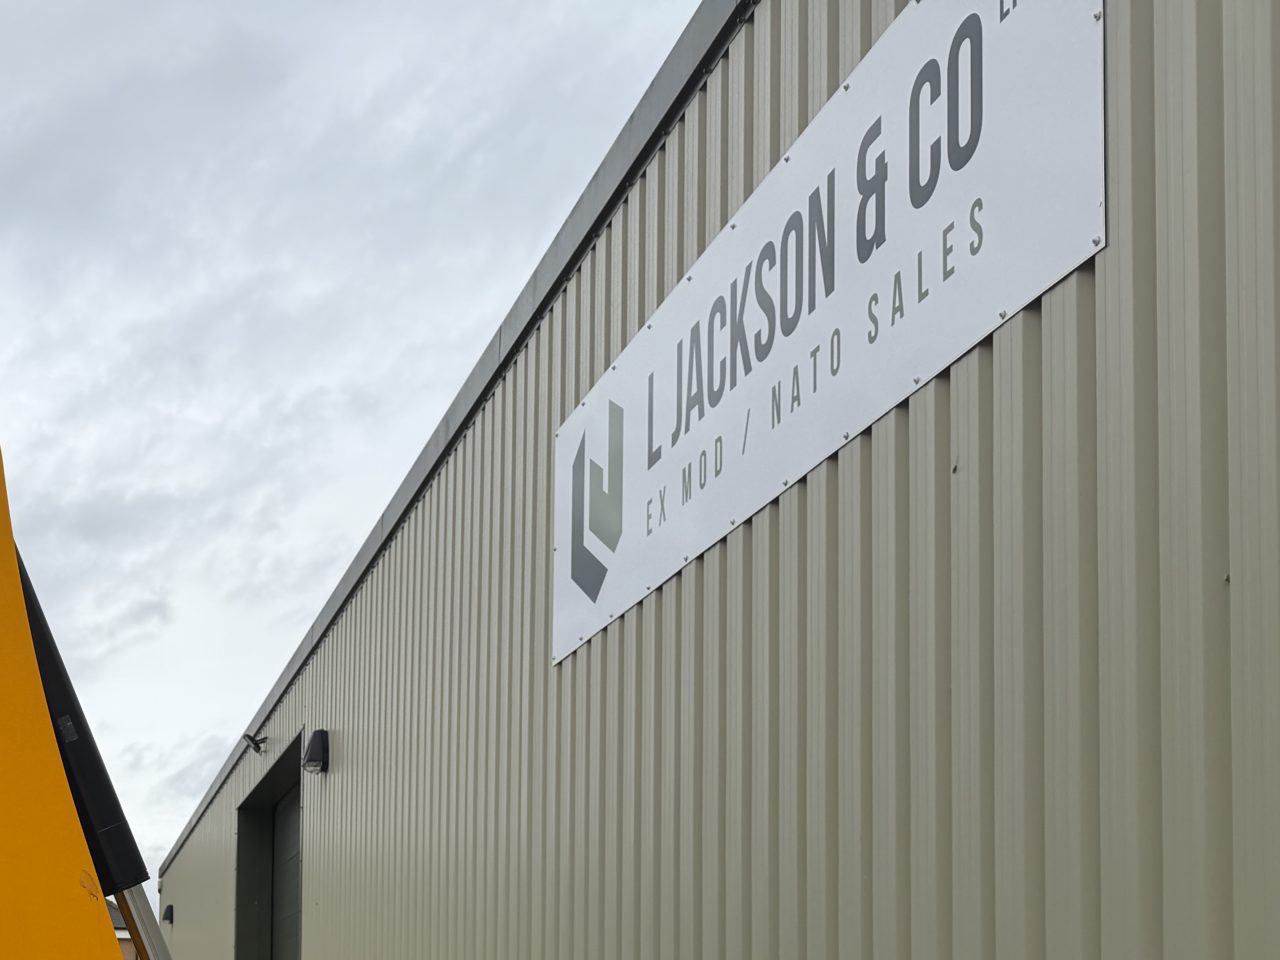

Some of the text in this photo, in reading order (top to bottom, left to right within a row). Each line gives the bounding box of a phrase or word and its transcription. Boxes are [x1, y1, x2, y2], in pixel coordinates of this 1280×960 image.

[646, 197, 983, 537] EX MOD / NATO SALES
[648, 12, 983, 471] L JACKSON & CO
